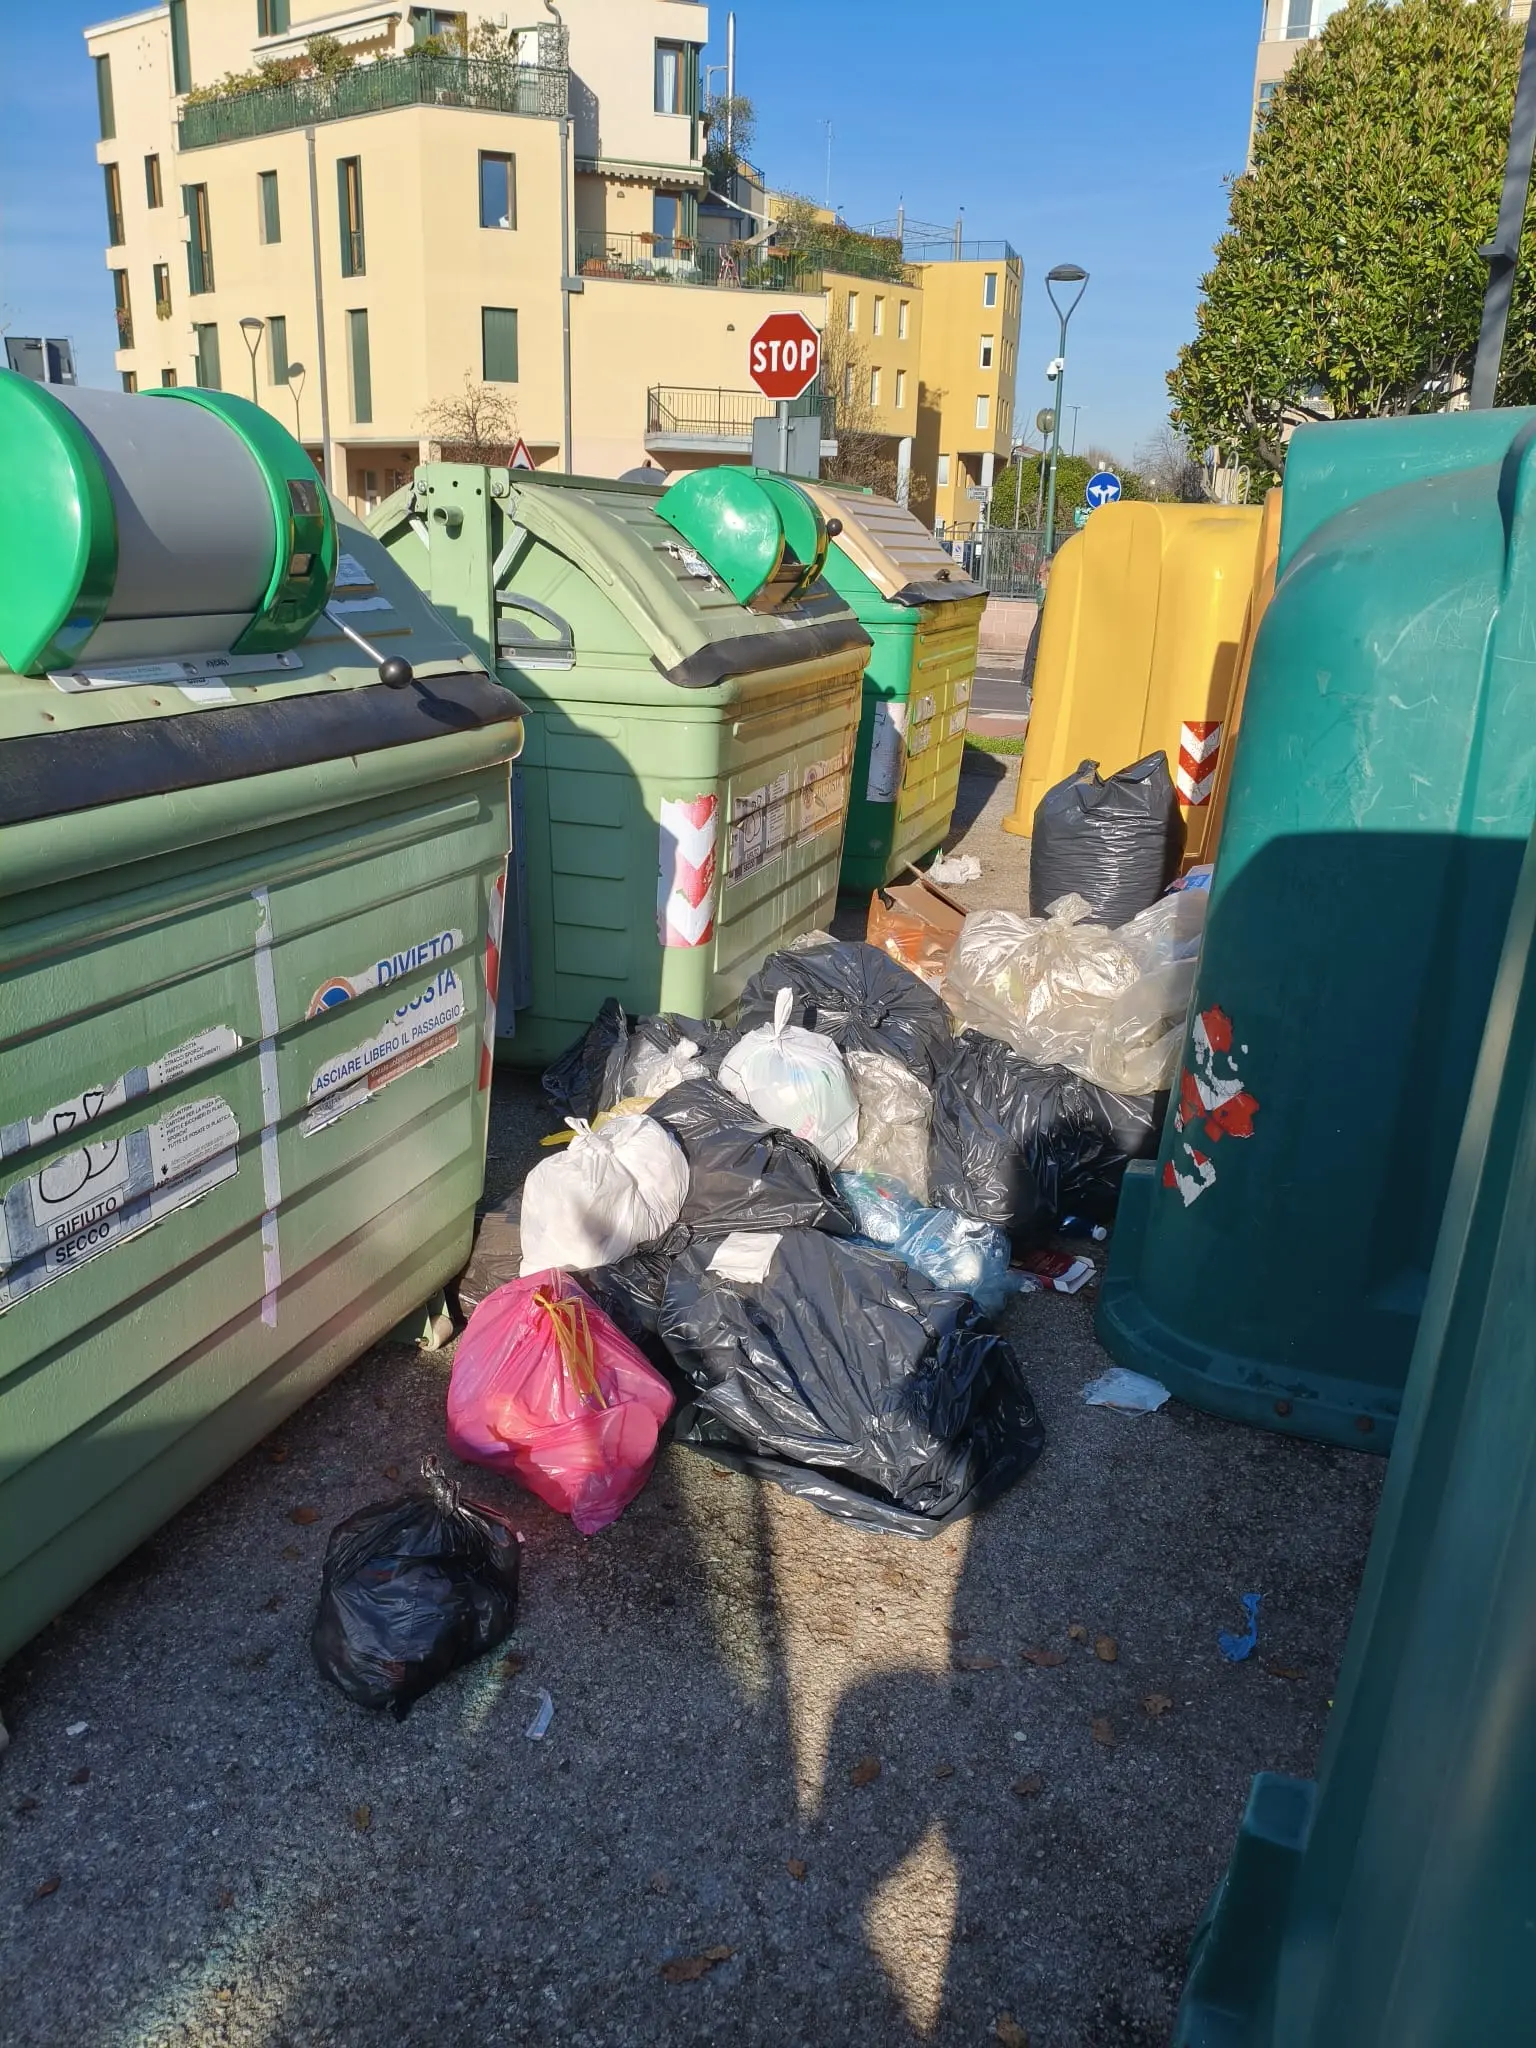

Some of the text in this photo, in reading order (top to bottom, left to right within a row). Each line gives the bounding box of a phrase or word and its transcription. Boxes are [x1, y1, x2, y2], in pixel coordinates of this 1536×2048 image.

[753, 339, 815, 373] STOP
[310, 1056, 362, 1094] LASCIARE
[364, 1037, 399, 1064] LIBERO
[401, 1034, 410, 1045] IL
[412, 1004, 461, 1040] PASSAGGIO
[168, 1138, 182, 1149] TUTTE
[55, 1197, 117, 1240] RIFIUTO
[55, 1222, 110, 1263] SECCO
